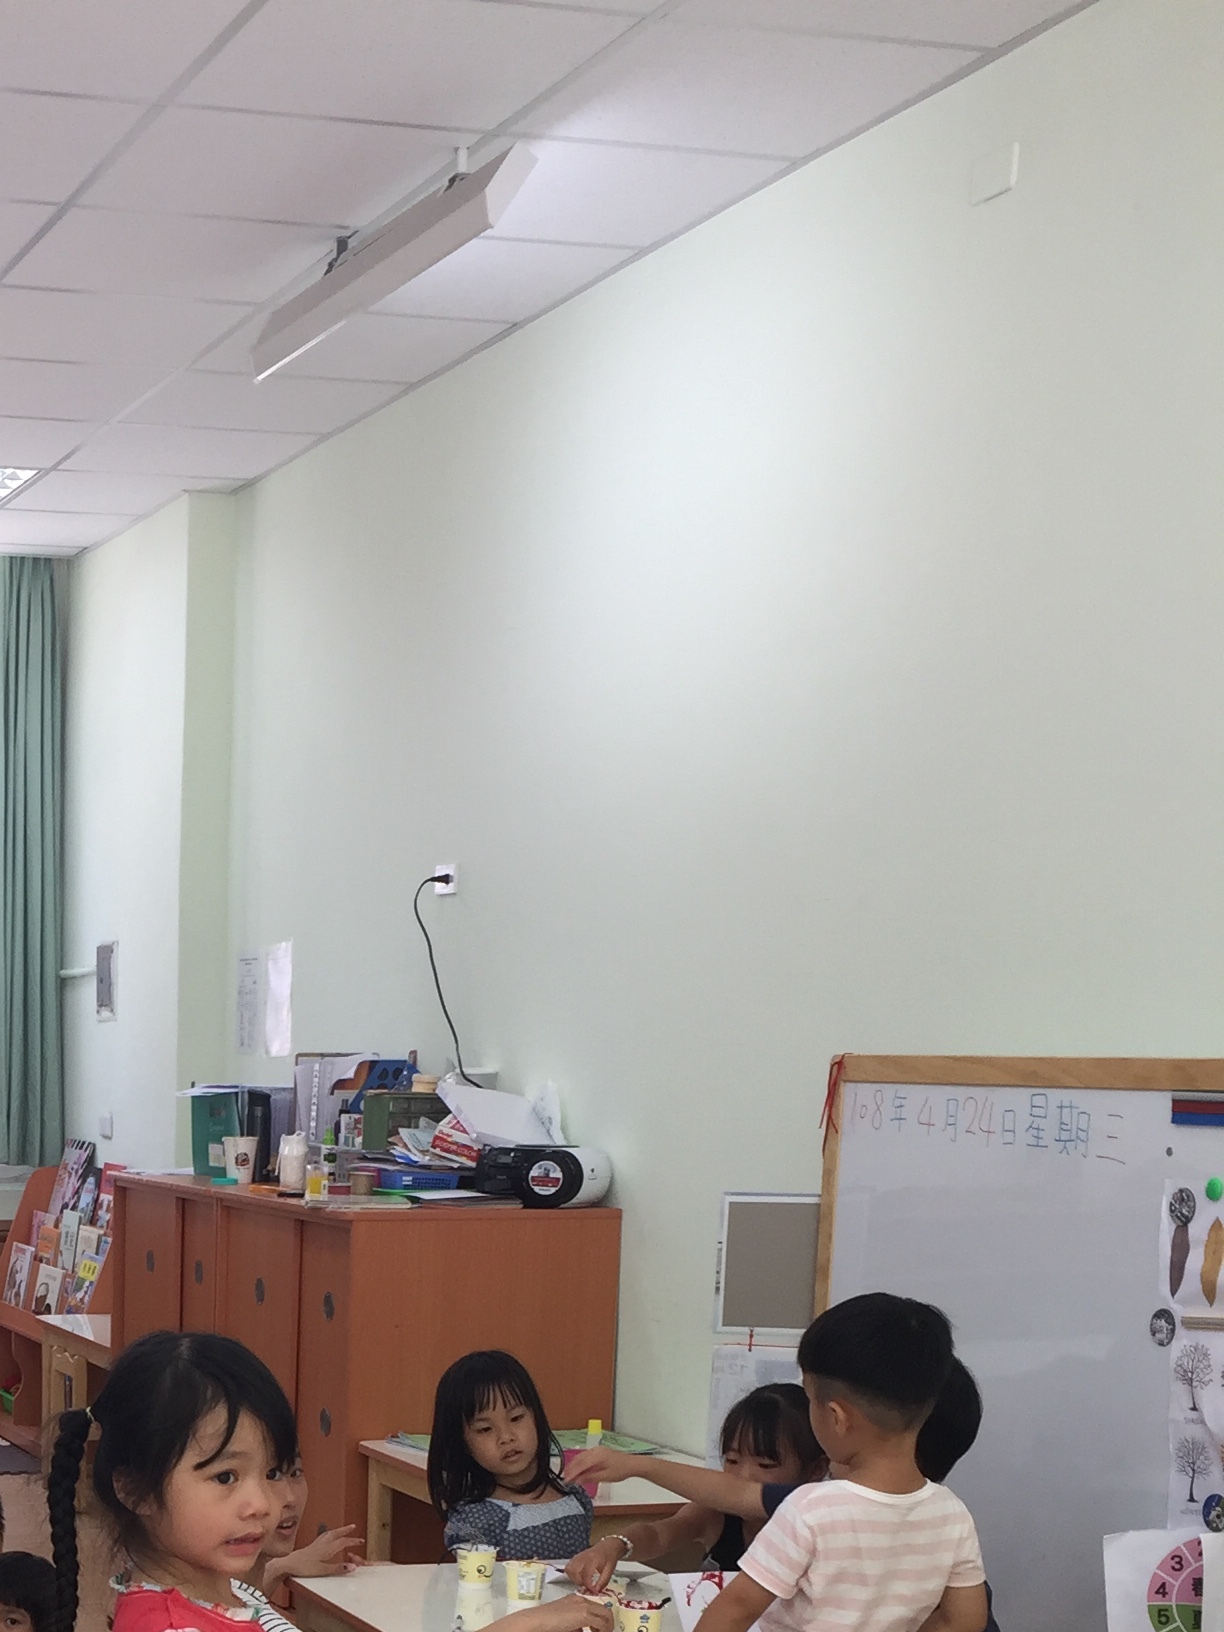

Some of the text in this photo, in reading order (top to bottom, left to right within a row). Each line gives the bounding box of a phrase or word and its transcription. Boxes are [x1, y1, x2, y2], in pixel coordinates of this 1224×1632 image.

[850, 1089, 1126, 1165] 108年4月24日星期三
[1170, 1554, 1184, 1572] 3
[1154, 1581, 1169, 1599] 4
[1157, 1608, 1170, 1625] 5
